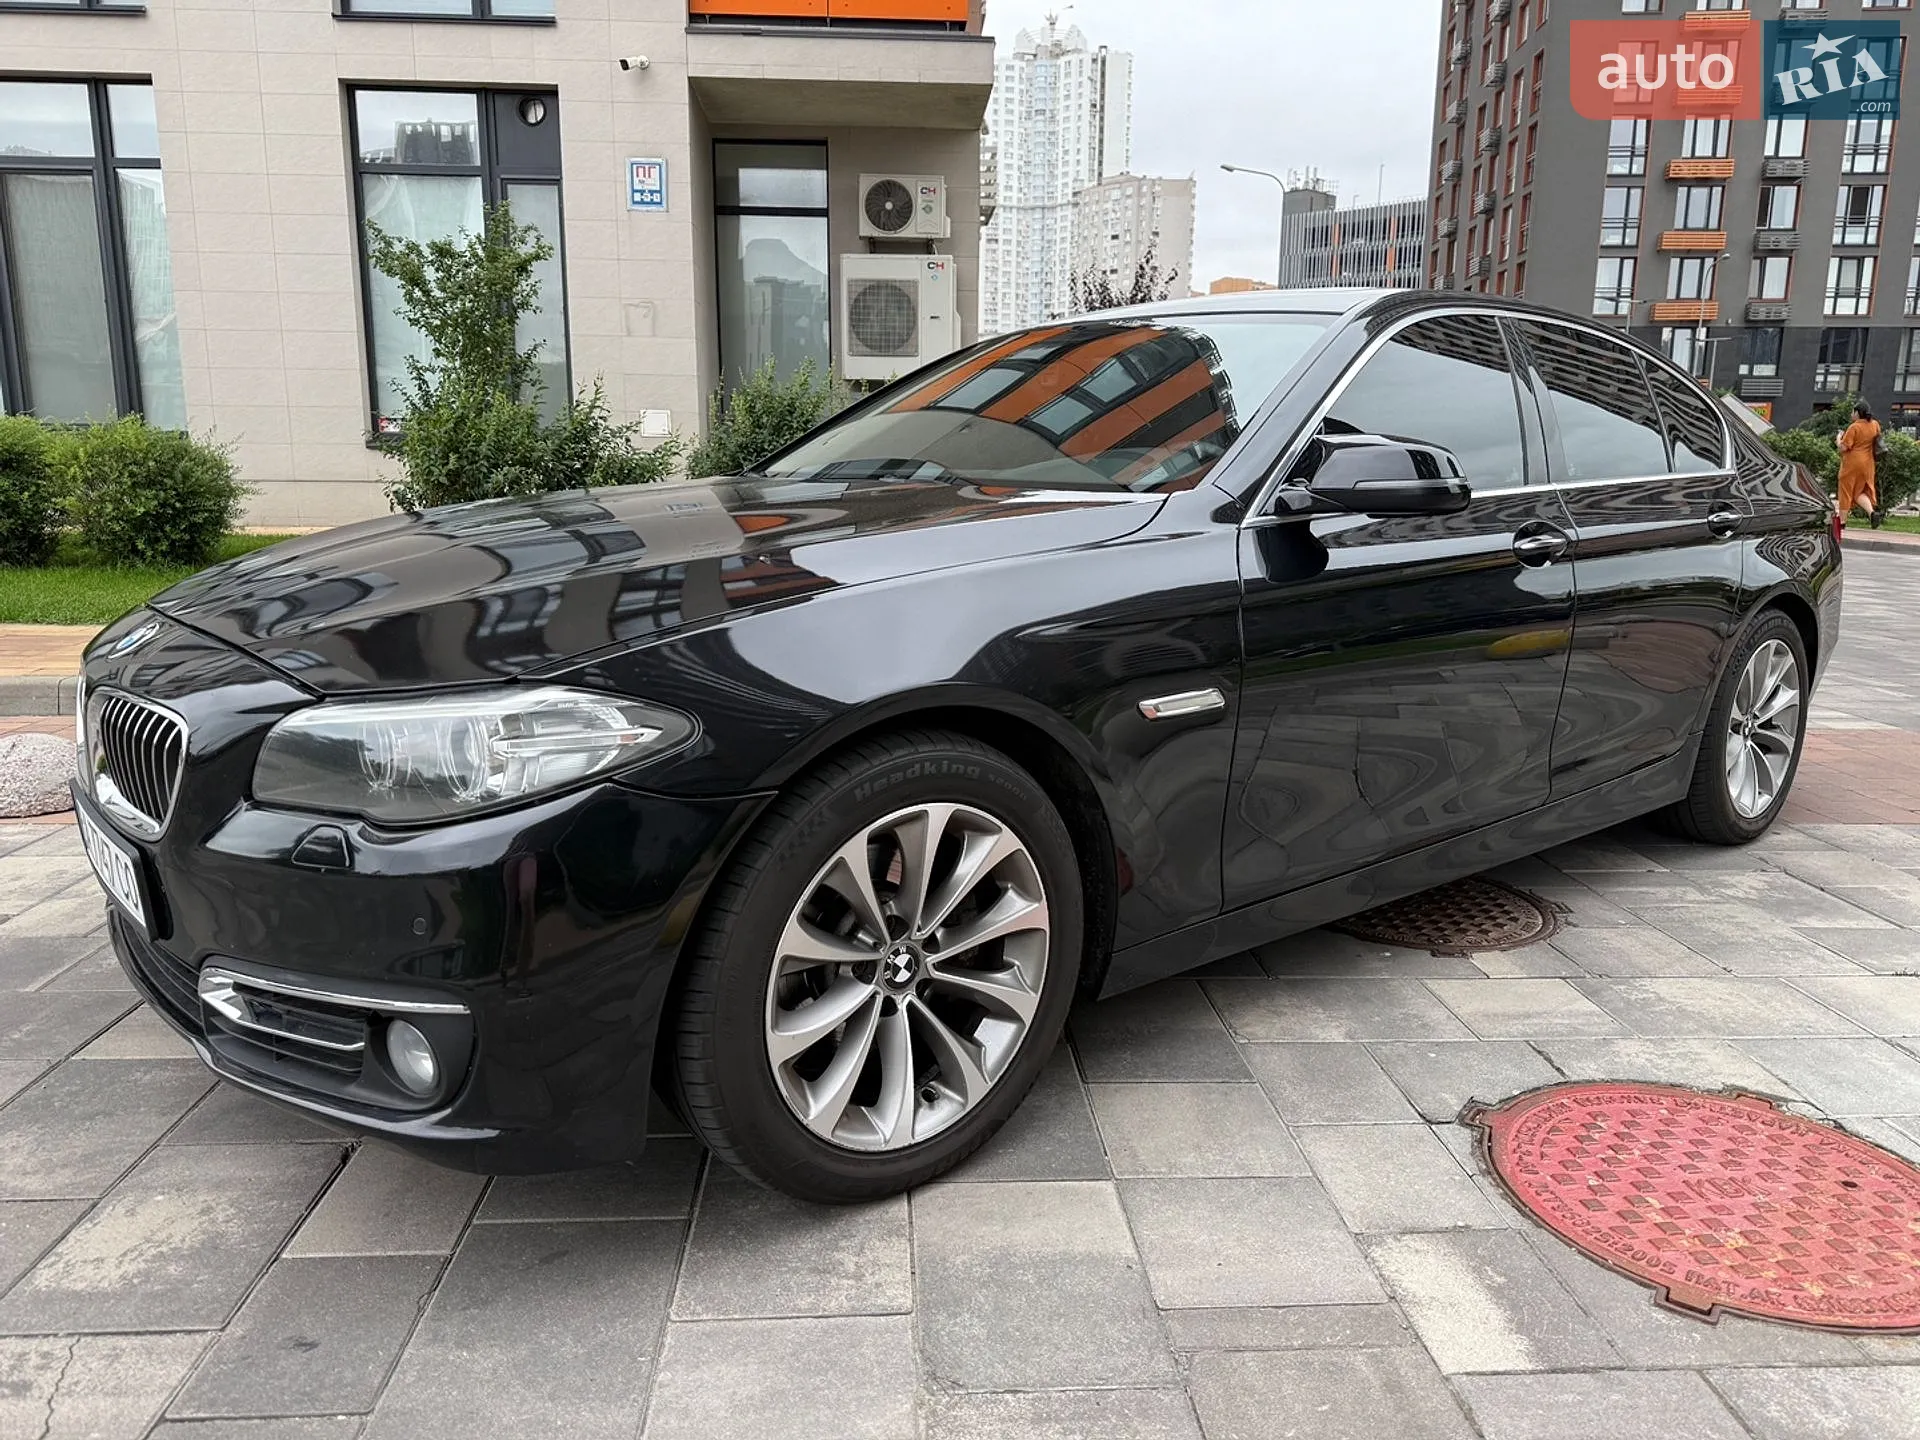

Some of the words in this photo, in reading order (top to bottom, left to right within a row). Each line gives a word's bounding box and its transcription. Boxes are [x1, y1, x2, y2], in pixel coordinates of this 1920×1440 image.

[919, 186, 936, 195] CH
[927, 261, 944, 270] CH
[852, 760, 982, 801] Headking
